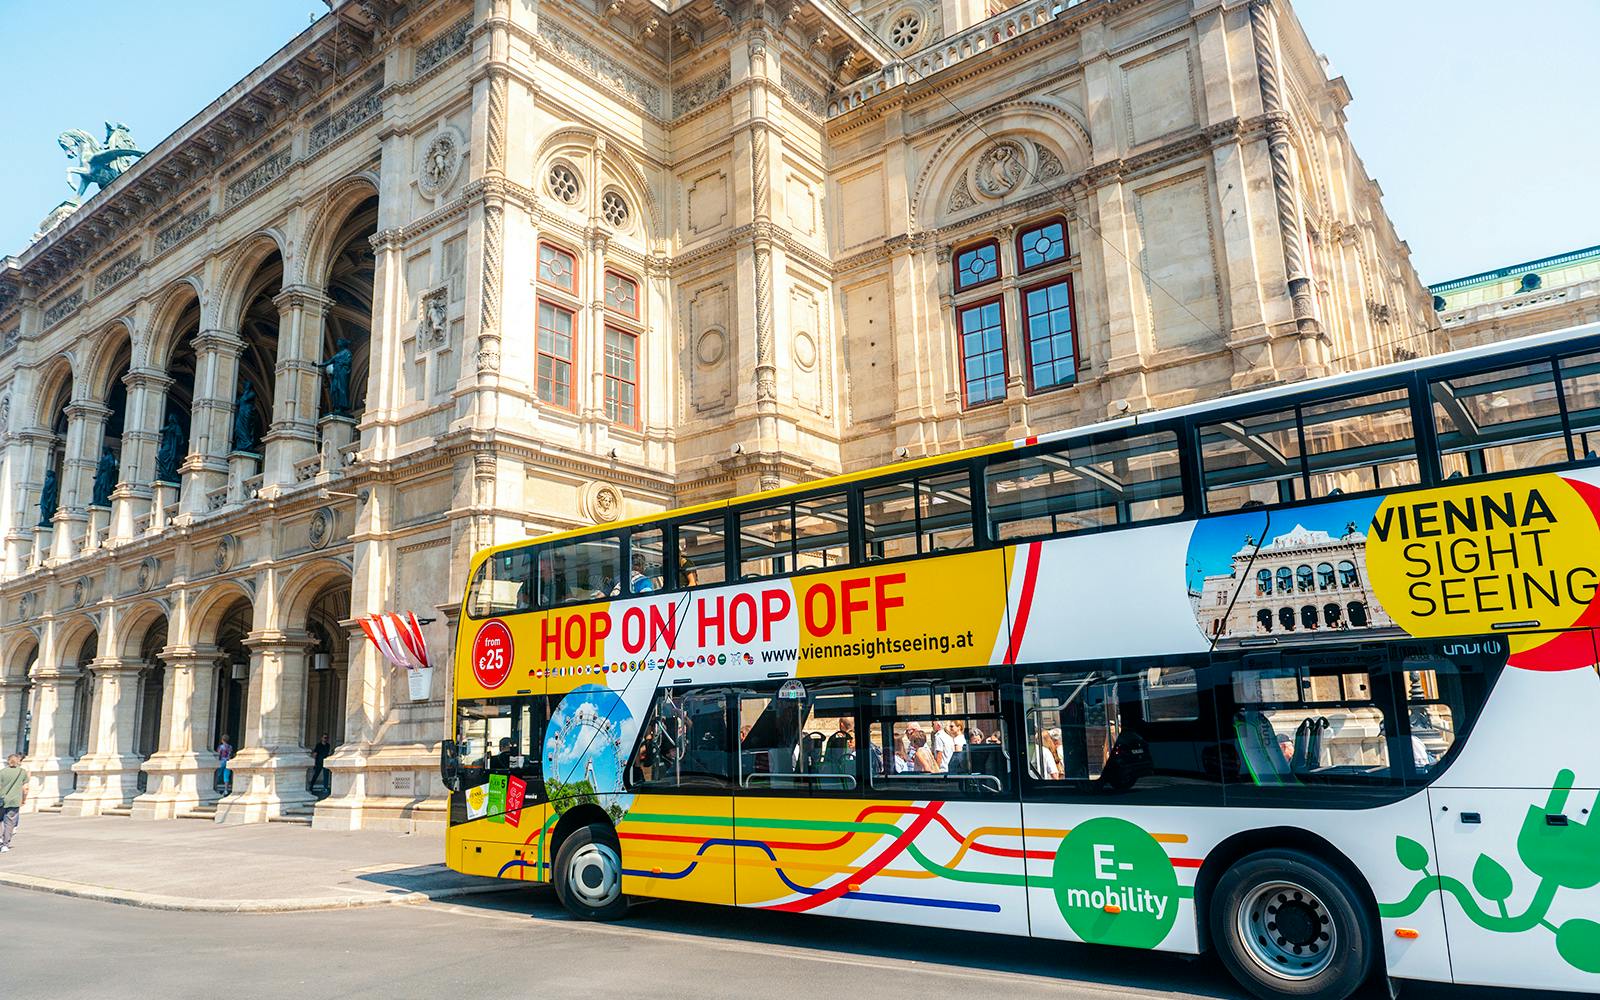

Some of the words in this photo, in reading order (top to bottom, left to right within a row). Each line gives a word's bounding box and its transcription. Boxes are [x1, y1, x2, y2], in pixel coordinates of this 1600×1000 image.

[1372, 489, 1558, 543] VIENNA
[1403, 529, 1551, 578] SIGHT
[1408, 567, 1600, 617] SEEING
[541, 611, 612, 662] HOP
[622, 602, 676, 654] ON
[697, 589, 791, 647] HOP
[804, 573, 906, 638] OFF
[479, 648, 504, 670] €25
[484, 637, 501, 646] from
[761, 630, 974, 662] www.viennasightseeing.at
[1093, 843, 1134, 880] E-
[1067, 885, 1168, 920] mobility
